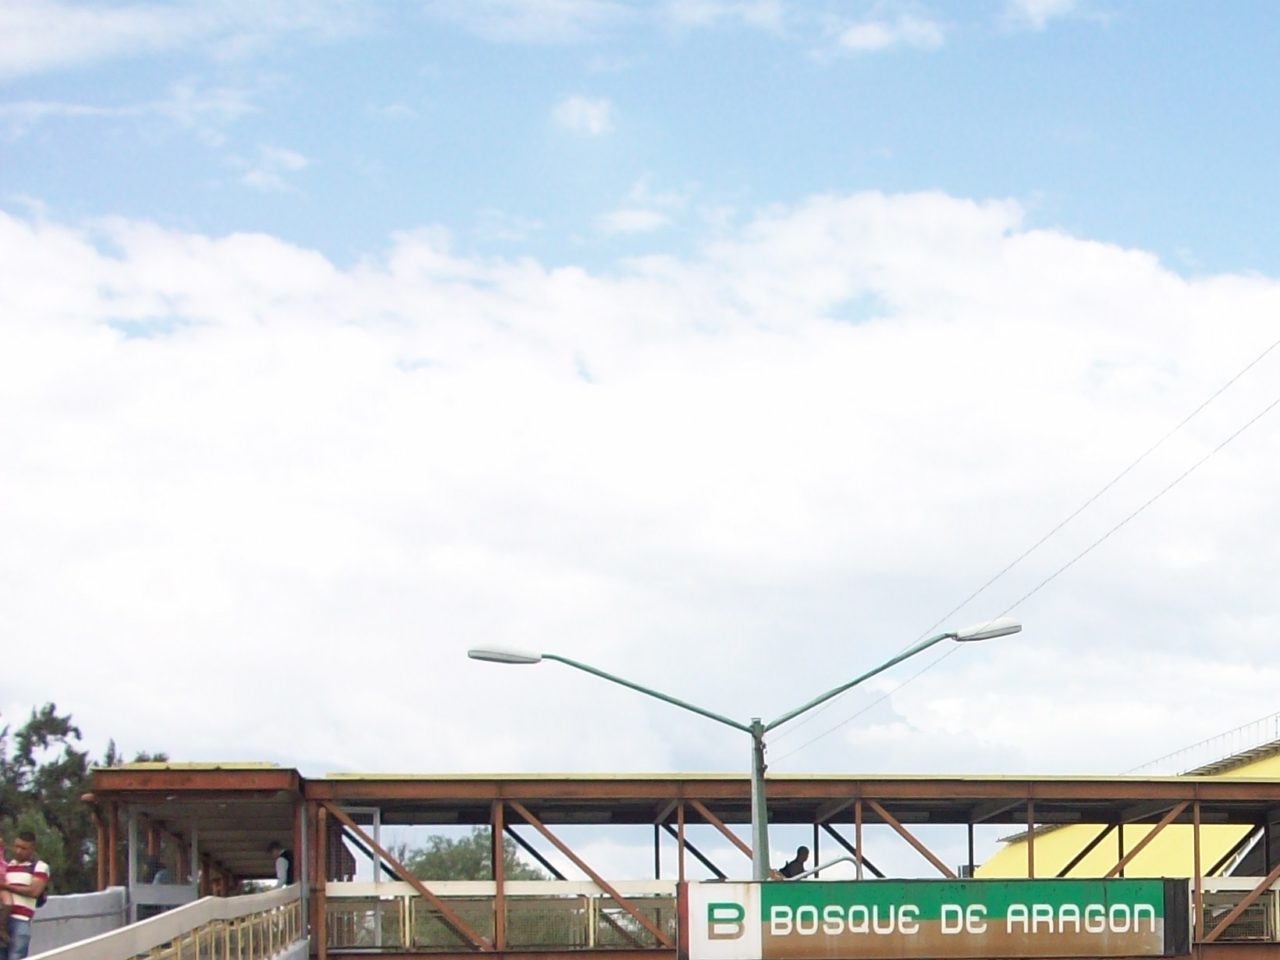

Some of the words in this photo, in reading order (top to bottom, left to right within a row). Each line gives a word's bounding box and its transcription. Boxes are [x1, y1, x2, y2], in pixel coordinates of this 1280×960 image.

[707, 902, 746, 940] B
[770, 904, 920, 936] BOSQUE
[940, 904, 988, 935] DE
[1006, 903, 1156, 935] ARAGON
